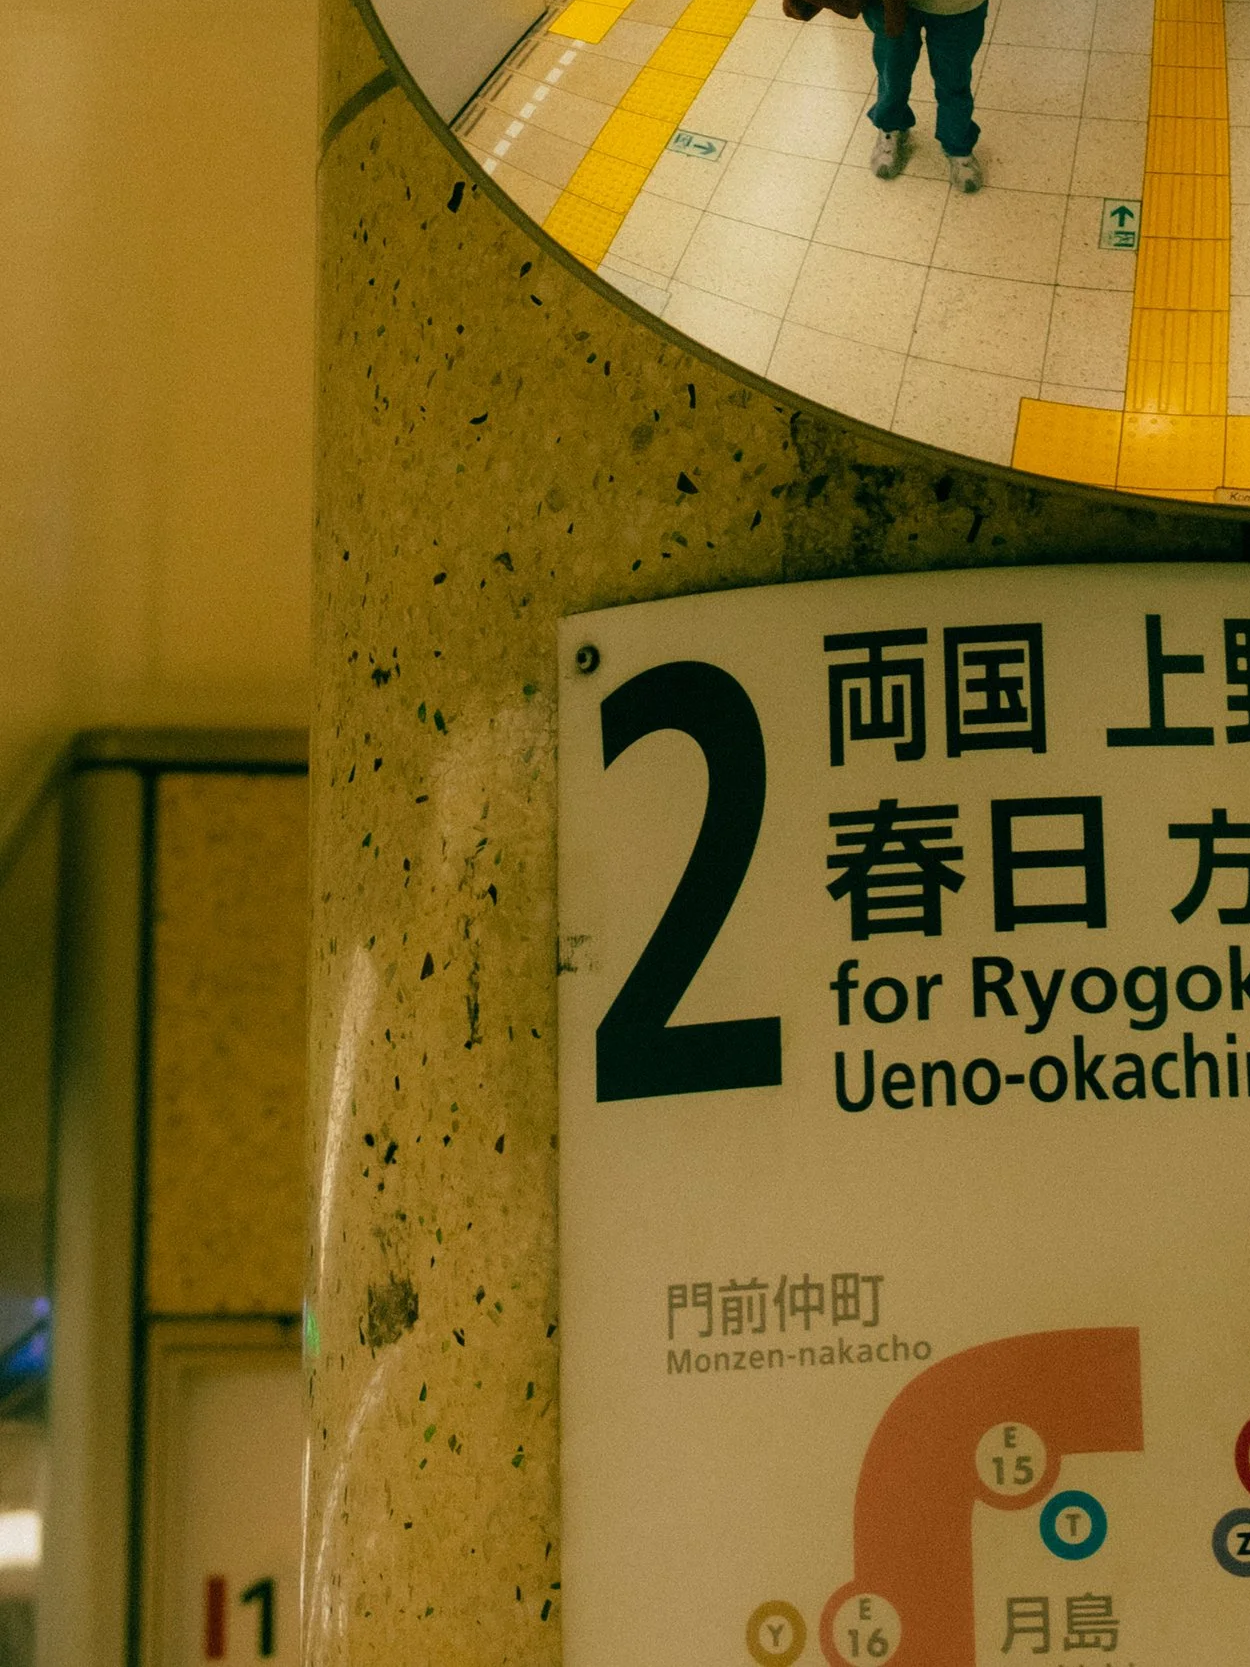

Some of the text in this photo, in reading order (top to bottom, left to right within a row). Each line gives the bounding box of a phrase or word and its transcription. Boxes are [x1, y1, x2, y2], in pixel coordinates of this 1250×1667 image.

[823, 622, 1047, 767] 両国
[595, 660, 782, 1103] 2
[825, 796, 1108, 942] 春日
[829, 959, 943, 1026] for
[667, 1272, 884, 1340] 門前仲町
[666, 1336, 933, 1375] Monzen-nakacho
[1003, 1425, 1018, 1449] E
[991, 1455, 1035, 1486] 15
[1064, 1513, 1082, 1537] T
[858, 1597, 872, 1621] E
[1000, 1591, 1120, 1655] 月島
[766, 1623, 785, 1648] Y
[847, 1627, 890, 1659] 16
